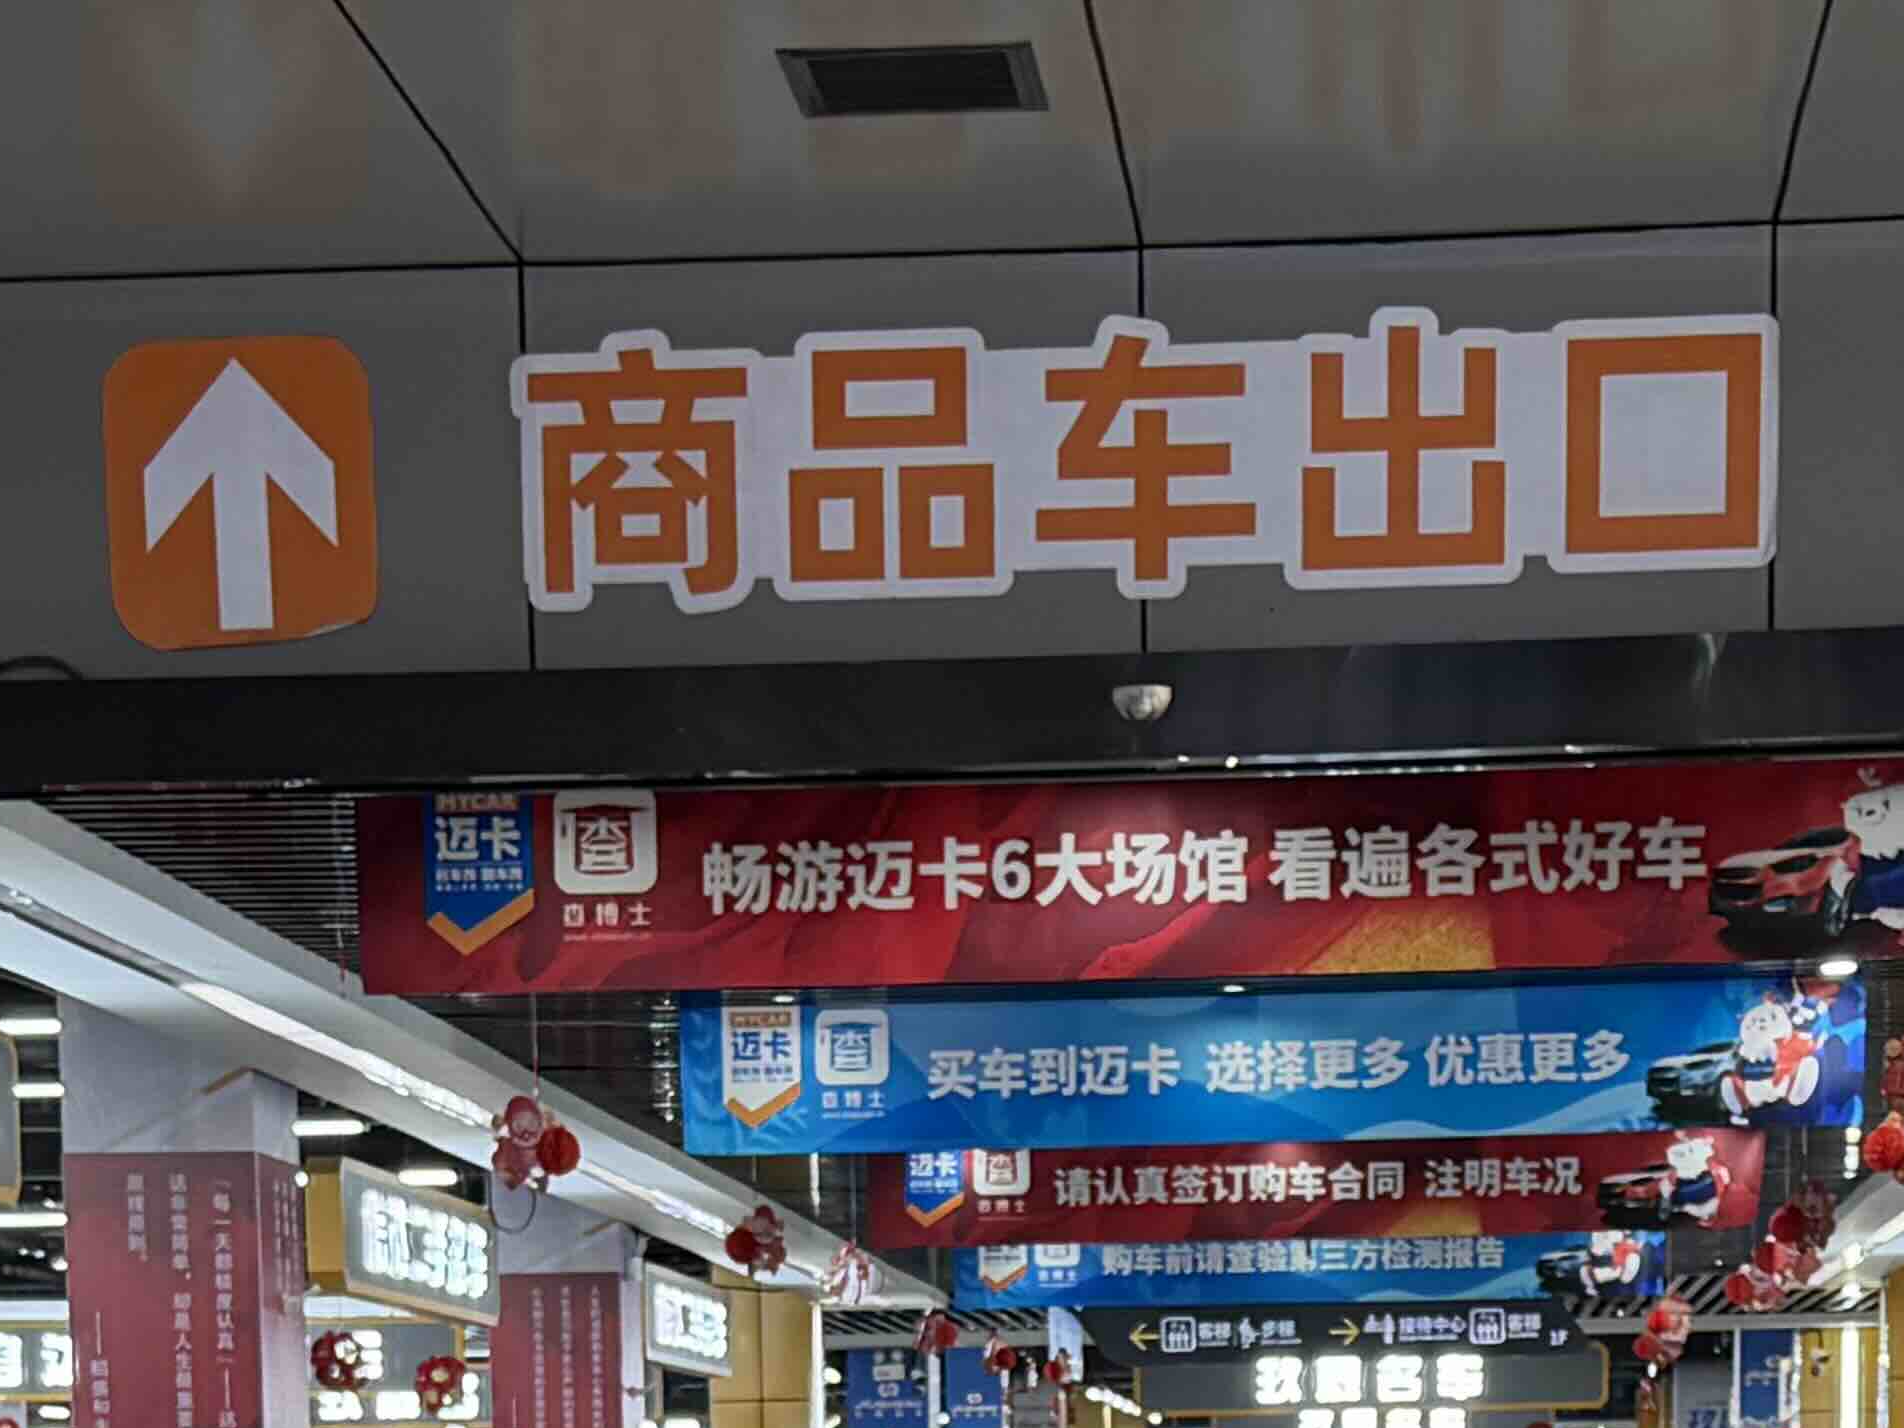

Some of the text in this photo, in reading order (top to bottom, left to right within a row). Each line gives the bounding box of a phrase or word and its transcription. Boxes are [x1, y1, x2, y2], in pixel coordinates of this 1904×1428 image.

[526, 322, 1768, 597] 商品车出口
[434, 816, 522, 862] 迈卡
[702, 816, 1707, 917] 畅游迈卡6大场馆 看遍各式好车
[731, 1031, 791, 1061] 迈卡
[928, 1029, 1632, 1100] 买车到迈卡 选择更多 优惠更多
[1054, 1156, 1584, 1208] 请认真签订购车合同 注明车况
[1101, 1238, 1505, 1277] 购车前请查验第三方检测报告
